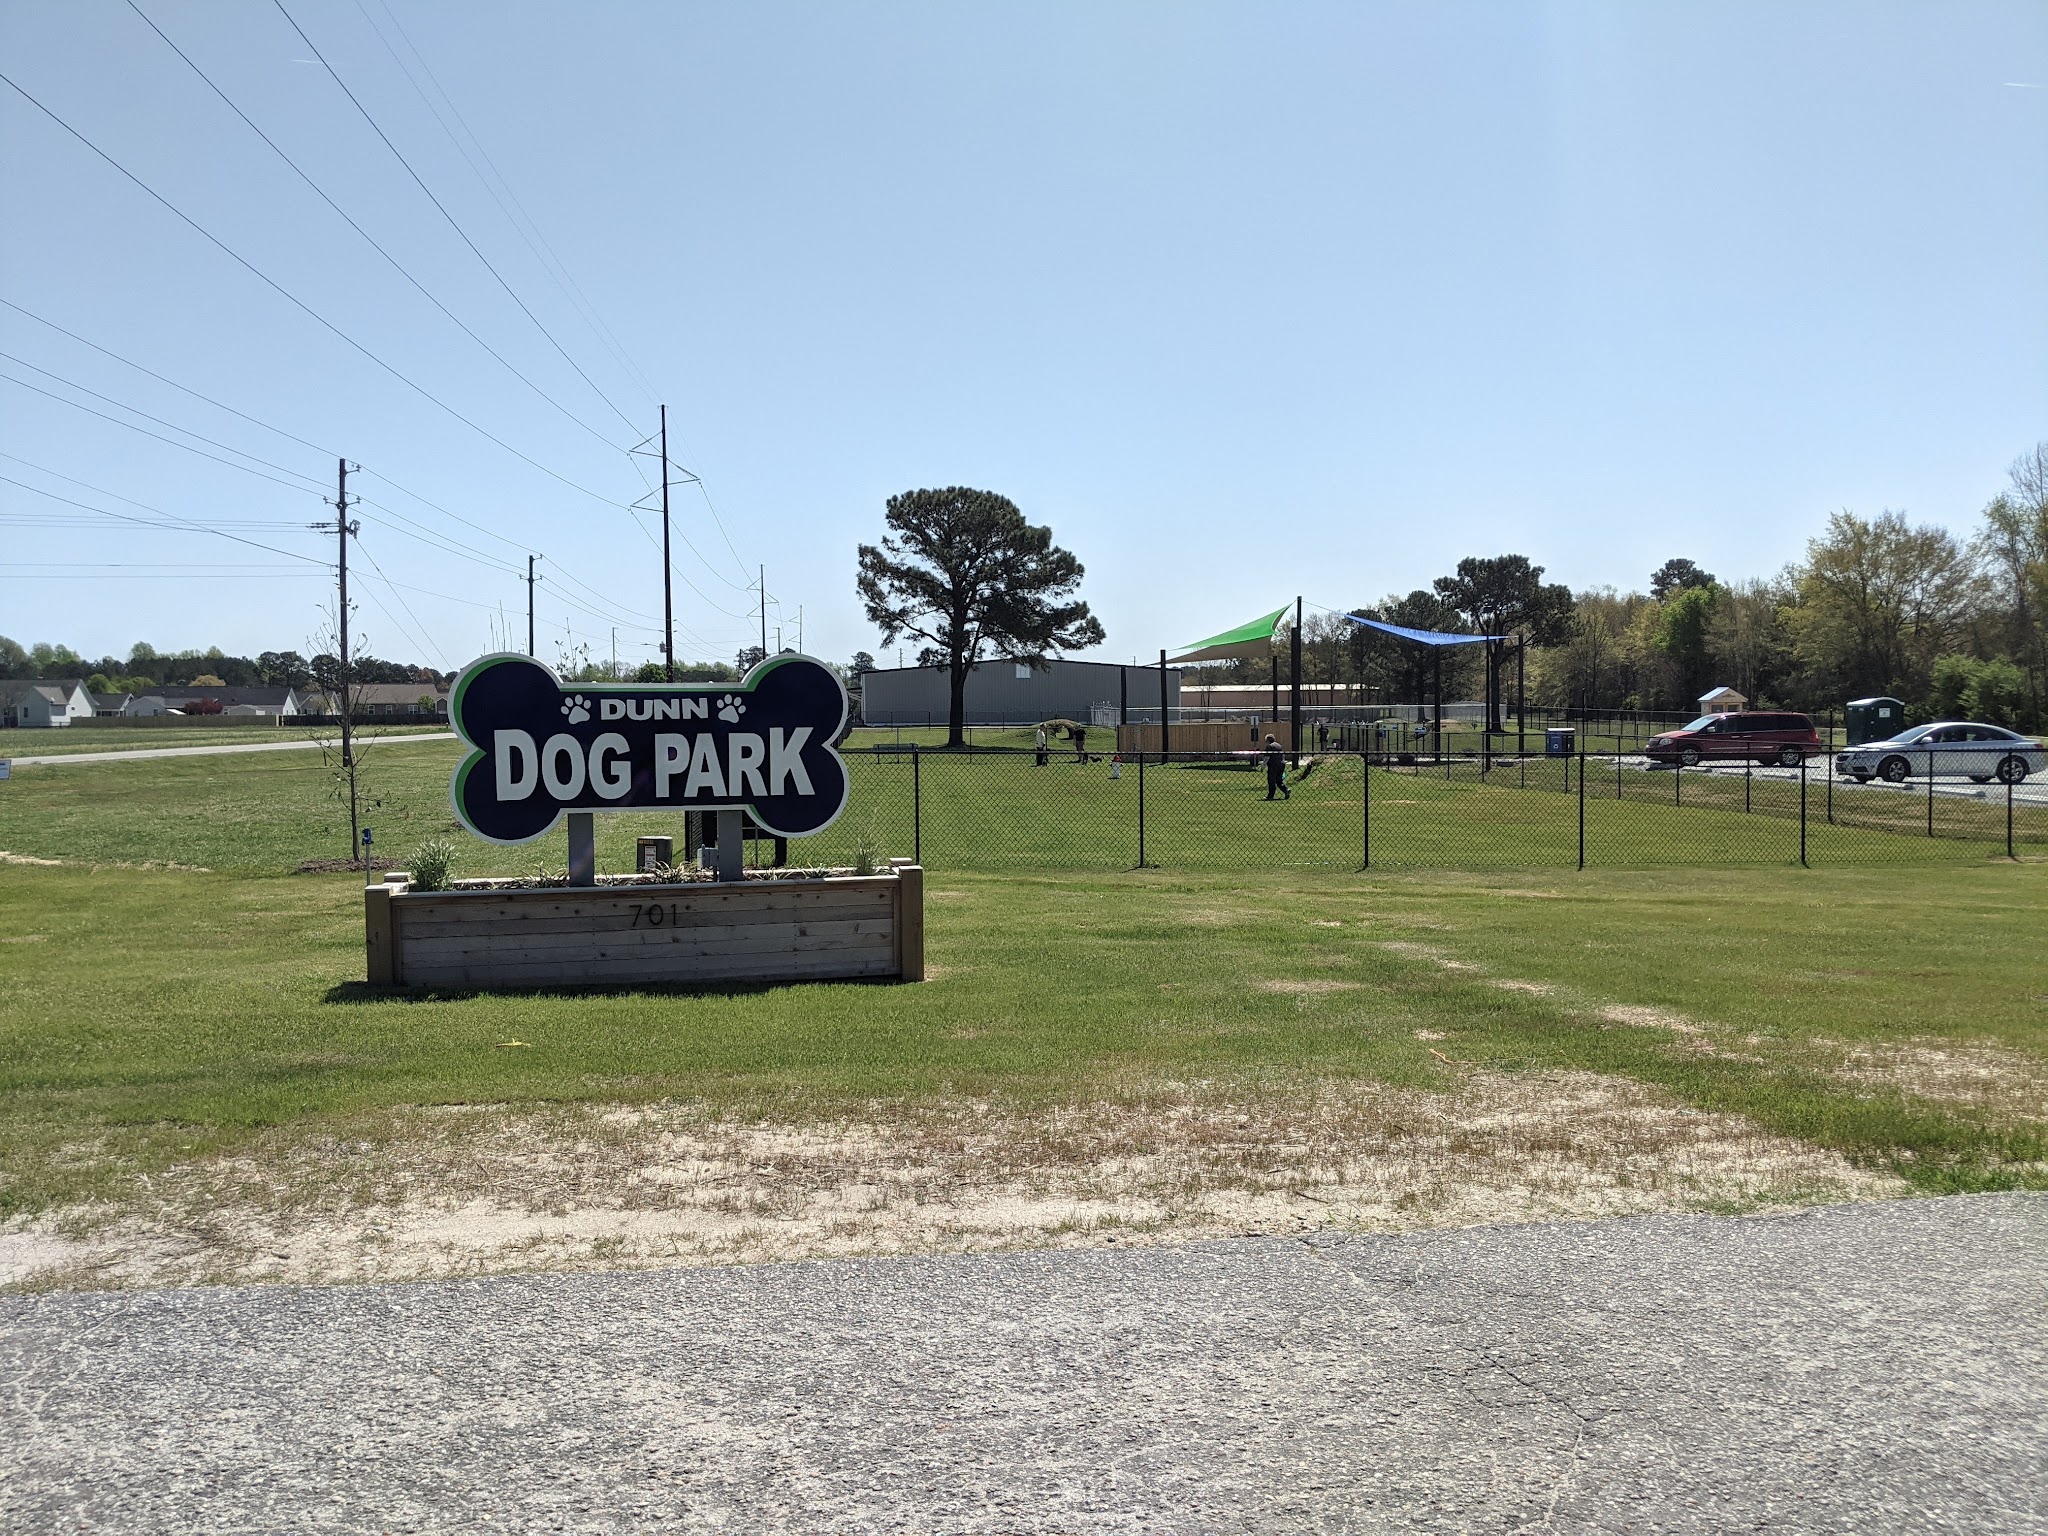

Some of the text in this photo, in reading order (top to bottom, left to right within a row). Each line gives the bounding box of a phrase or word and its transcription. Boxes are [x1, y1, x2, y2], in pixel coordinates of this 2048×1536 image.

[600, 697, 709, 721] DUNN
[493, 726, 816, 801] DOG PARK
[628, 903, 677, 928] 701
